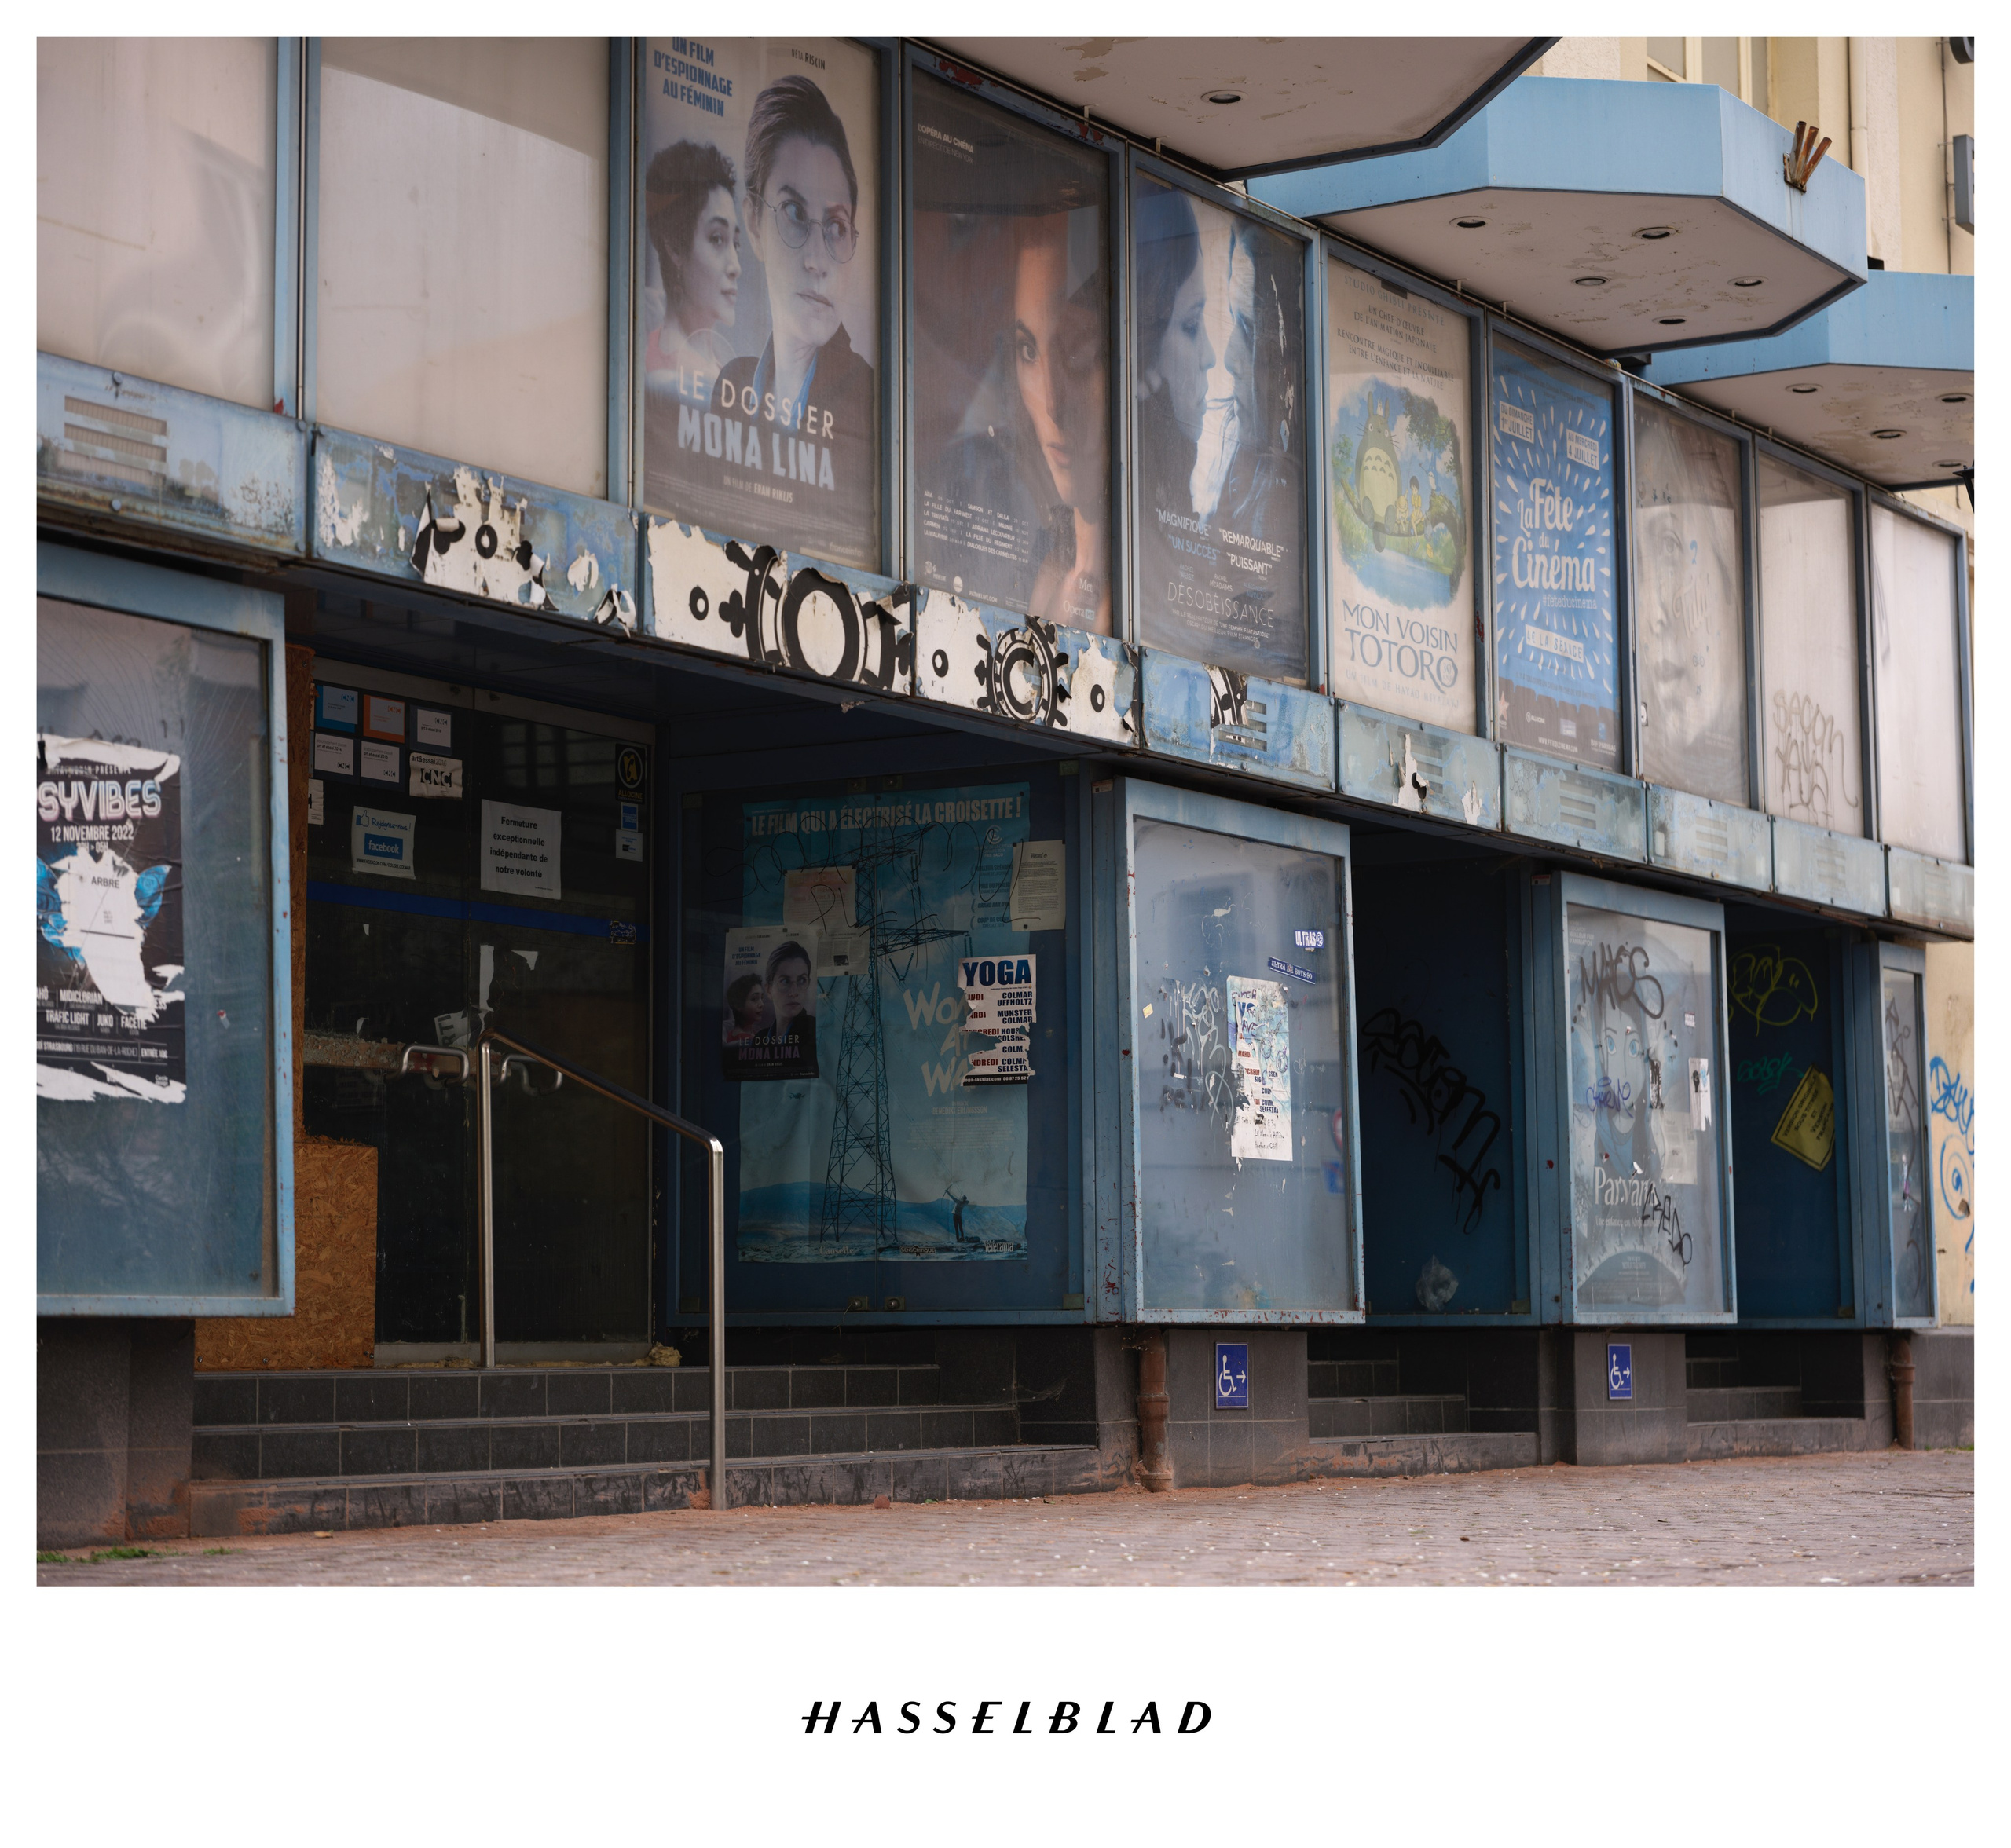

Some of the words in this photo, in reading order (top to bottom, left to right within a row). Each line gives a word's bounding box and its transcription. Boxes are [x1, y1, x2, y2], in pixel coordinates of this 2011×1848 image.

[672, 37, 687, 56] UN
[690, 40, 714, 67] FILM
[791, 49, 804, 61] NETA
[805, 53, 825, 70] RISKIN
[654, 50, 733, 97] D'ESPIONNAGE
[663, 79, 678, 99] AU
[680, 85, 723, 117] FÉMININ
[943, 134, 952, 144] AU
[1345, 276, 1375, 295] STUDIO
[1378, 290, 1405, 309] GHIBLI
[1368, 305, 1377, 314] UN
[1354, 311, 1363, 321] DE
[1366, 316, 1403, 339] L'ANIMATION
[1337, 328, 1375, 349] RENCONTRE
[1378, 344, 1405, 363] MAGIQUE
[1406, 357, 1412, 366] ET
[1349, 345, 1368, 360] ENTRE
[680, 365, 705, 401] LE
[721, 379, 833, 439] DOSSIER
[1500, 404, 1508, 415] DU
[1509, 407, 1533, 425] DIMANCHE
[1508, 419, 1533, 441] JUILLET
[678, 404, 762, 470] MONA
[772, 432, 835, 491] LINA
[1568, 432, 1574, 442] AU
[1575, 435, 1597, 452] MERCREDI
[1569, 445, 1572, 457] 4
[1573, 447, 1597, 467] JUILLET
[754, 483, 770, 497] ERAN
[772, 488, 793, 503] RIKLIS
[968, 503, 983, 513] SAMSON
[1518, 498, 1533, 538] La
[1529, 478, 1573, 532] Fête
[924, 520, 940, 529] CARMEN
[1539, 532, 1550, 548] du
[1512, 536, 1595, 591] Cinéma
[1079, 578, 1093, 592] Met
[1214, 573, 1228, 583] RACHEL
[1064, 601, 1084, 618] Opera
[1167, 581, 1274, 628] DÉSOBÉISSANCE
[1543, 595, 1597, 609] #feteducinema
[1342, 599, 1389, 635] MON
[1397, 616, 1457, 654] VOISIN
[1540, 635, 1548, 648] LA
[1345, 627, 1458, 694] TOTORO
[341, 693, 354, 702] CNC
[1383, 680, 1391, 691] DE
[1396, 683, 1419, 699] HAYAO
[388, 705, 401, 714] CNC
[435, 717, 448, 726] CNC
[420, 768, 452, 787] CNC
[501, 817, 537, 829] Fermeture
[752, 815, 765, 836] LE
[768, 812, 798, 834] FILM
[801, 810, 825, 832] QUI
[828, 810, 837, 830] A
[840, 801, 913, 829] ÉLECTRISÉ
[915, 806, 932, 825] LA
[935, 797, 1013, 823] CROISETTE
[51, 826, 61, 842] 12
[64, 825, 110, 842] NOVEMBRE
[112, 825, 134, 840] 2022
[493, 833, 545, 846] exceptionnelle
[368, 840, 399, 854] facebook
[490, 847, 537, 861] indépendante
[516, 869, 542, 878] volonté
[91, 876, 119, 888] ARBRE
[1295, 931, 1316, 946] ULTRAS
[962, 959, 1032, 986] YOGA
[1271, 961, 1285, 971] ULTRA
[1295, 968, 1306, 978] BOYS
[46, 1010, 69, 1024] TRAFIC
[71, 1012, 90, 1026] LIGHT
[97, 1014, 113, 1027] JUKO
[998, 1009, 1032, 1018] MUNSTER
[44, 1041, 72, 1052] STRASBOURG
[739, 1037, 749, 1046] LE
[755, 1034, 800, 1045] DOSSIER
[141, 1048, 158, 1058] ENTRÉE
[738, 1047, 771, 1060] MONA
[774, 1045, 800, 1059] LINA
[820, 1245, 854, 1256] Causette
